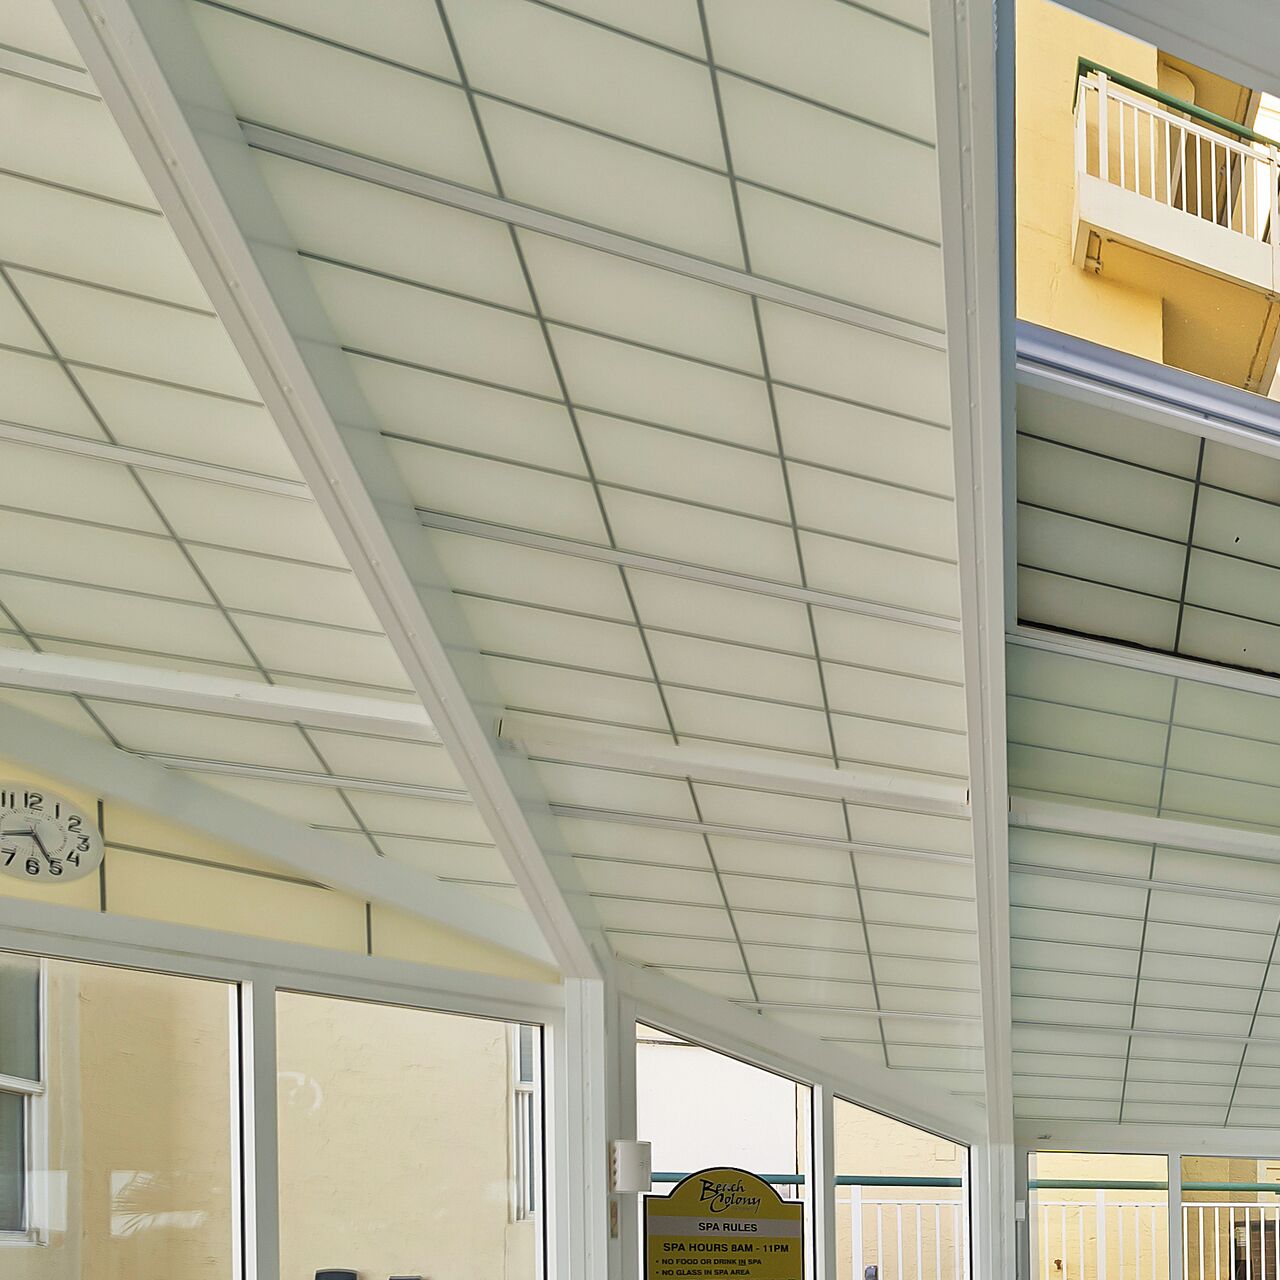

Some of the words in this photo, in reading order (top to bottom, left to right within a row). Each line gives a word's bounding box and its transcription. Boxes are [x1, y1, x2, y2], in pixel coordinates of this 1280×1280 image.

[1, 791, 14, 809] 11
[24, 791, 43, 811] 12
[55, 803, 60, 819] 1
[68, 815, 82, 833] 2
[77, 834, 90, 852] 3
[1, 848, 17, 866] 7
[25, 857, 40, 875] 6
[66, 850, 80, 867] 4
[49, 857, 63, 876] 5
[699, 1179, 745, 1201] Beach
[710, 1192, 761, 1213] Colony
[698, 1222, 720, 1231] SPA
[723, 1223, 757, 1232] RULES
[663, 1243, 685, 1252] SPA
[689, 1243, 728, 1252] HOURS
[731, 1244, 752, 1252] 8AM
[763, 1244, 789, 1253] 11PM
